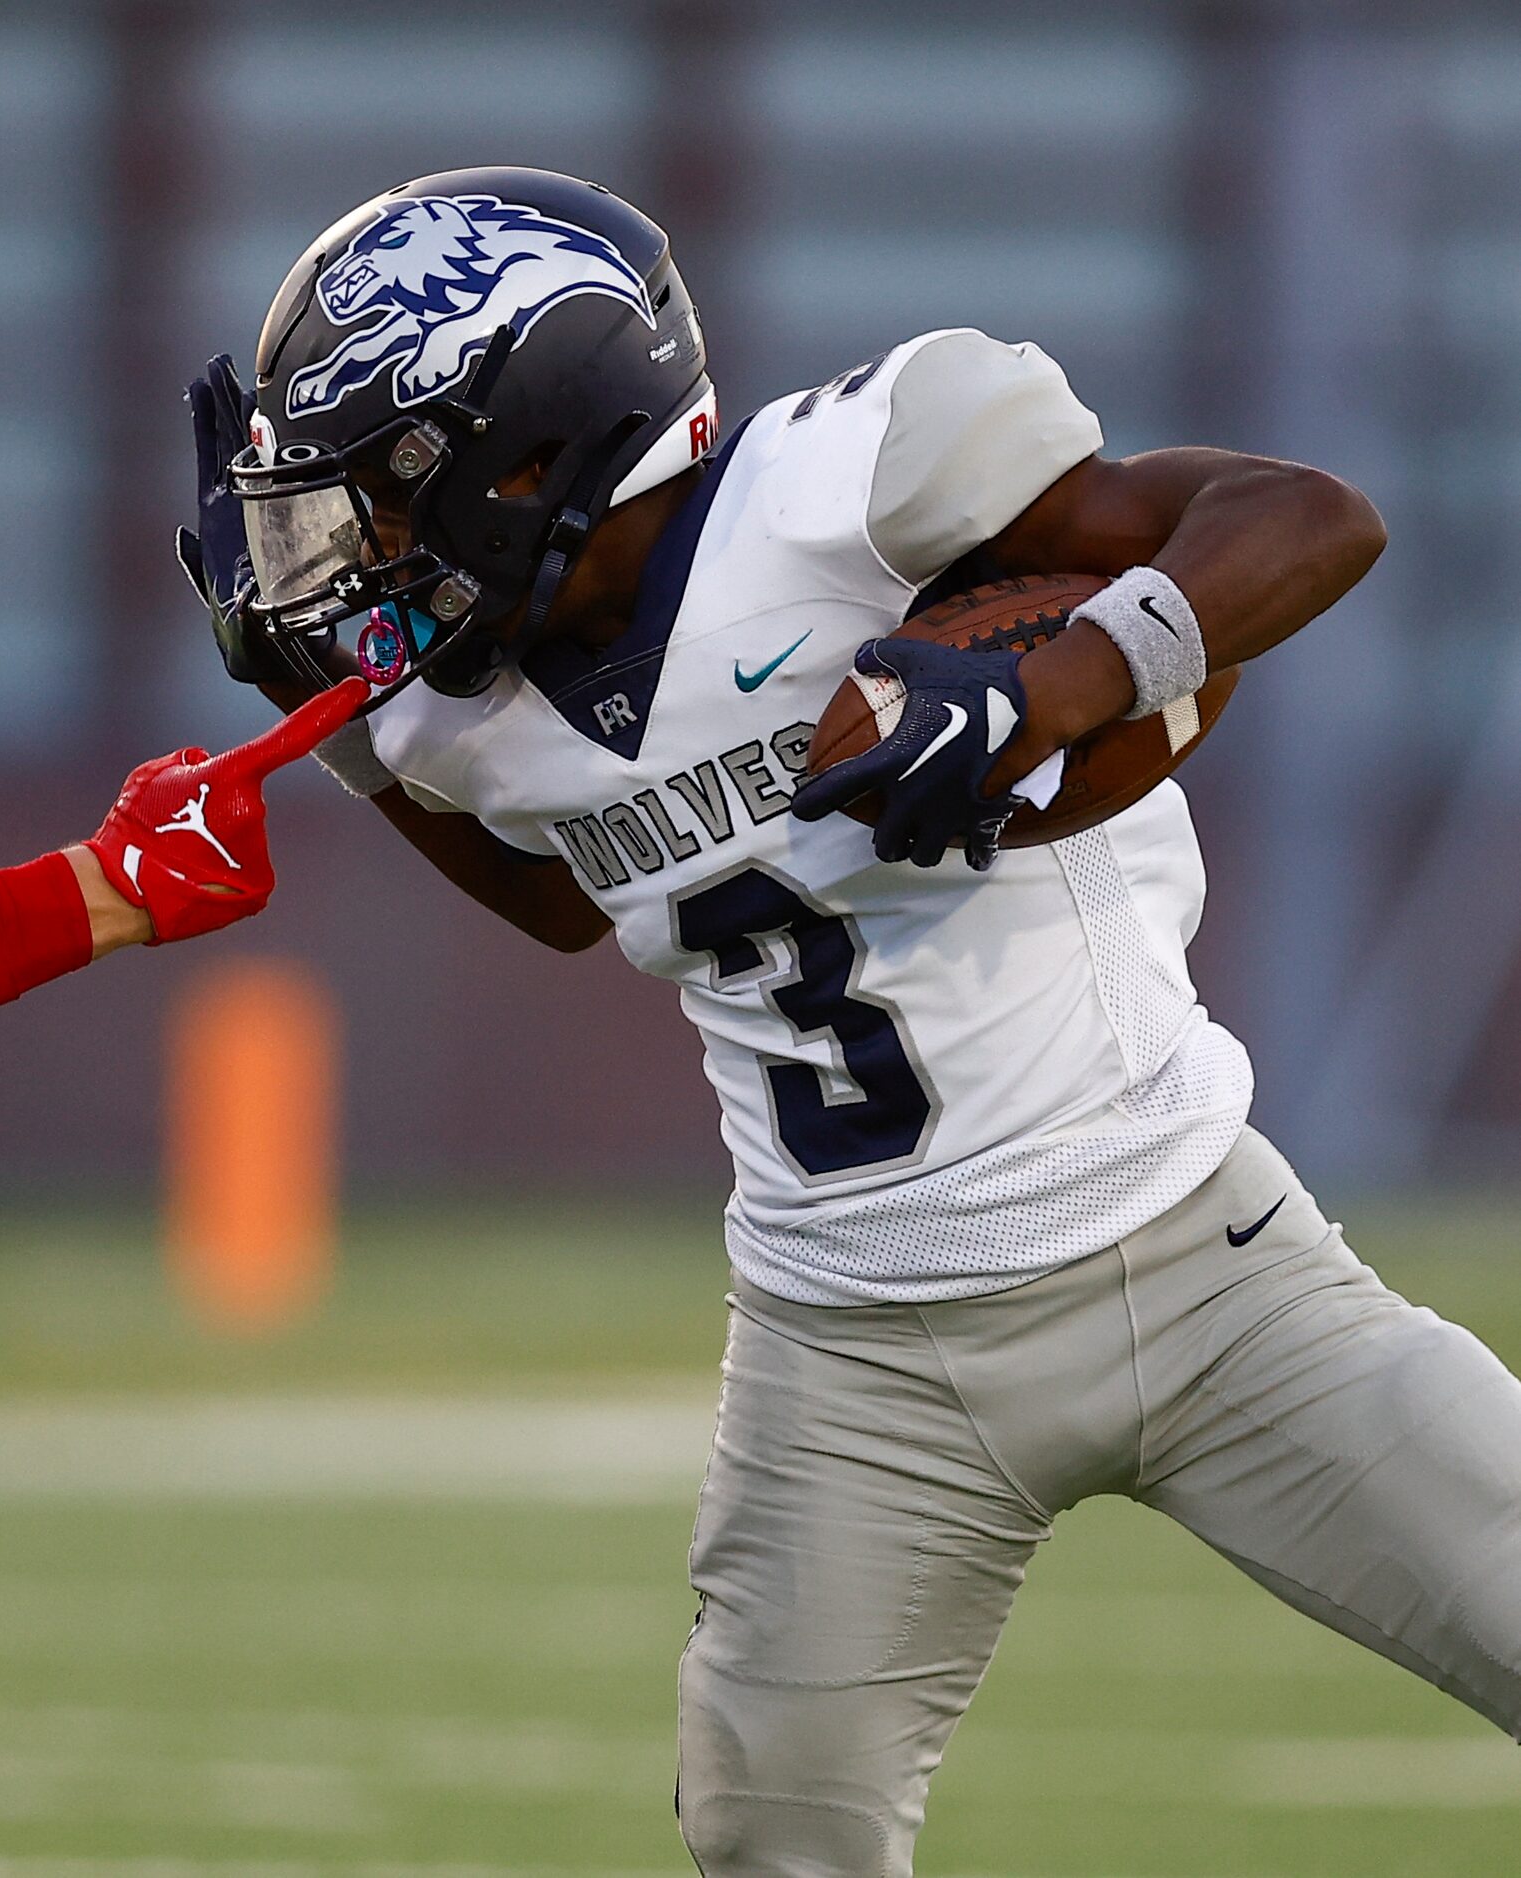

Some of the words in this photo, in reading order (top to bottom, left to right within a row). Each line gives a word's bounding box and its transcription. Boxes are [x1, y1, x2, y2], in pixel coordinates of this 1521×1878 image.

[649, 338, 678, 361] Riddell
[553, 719, 818, 890] WOLVES
[667, 856, 945, 1188] 3
